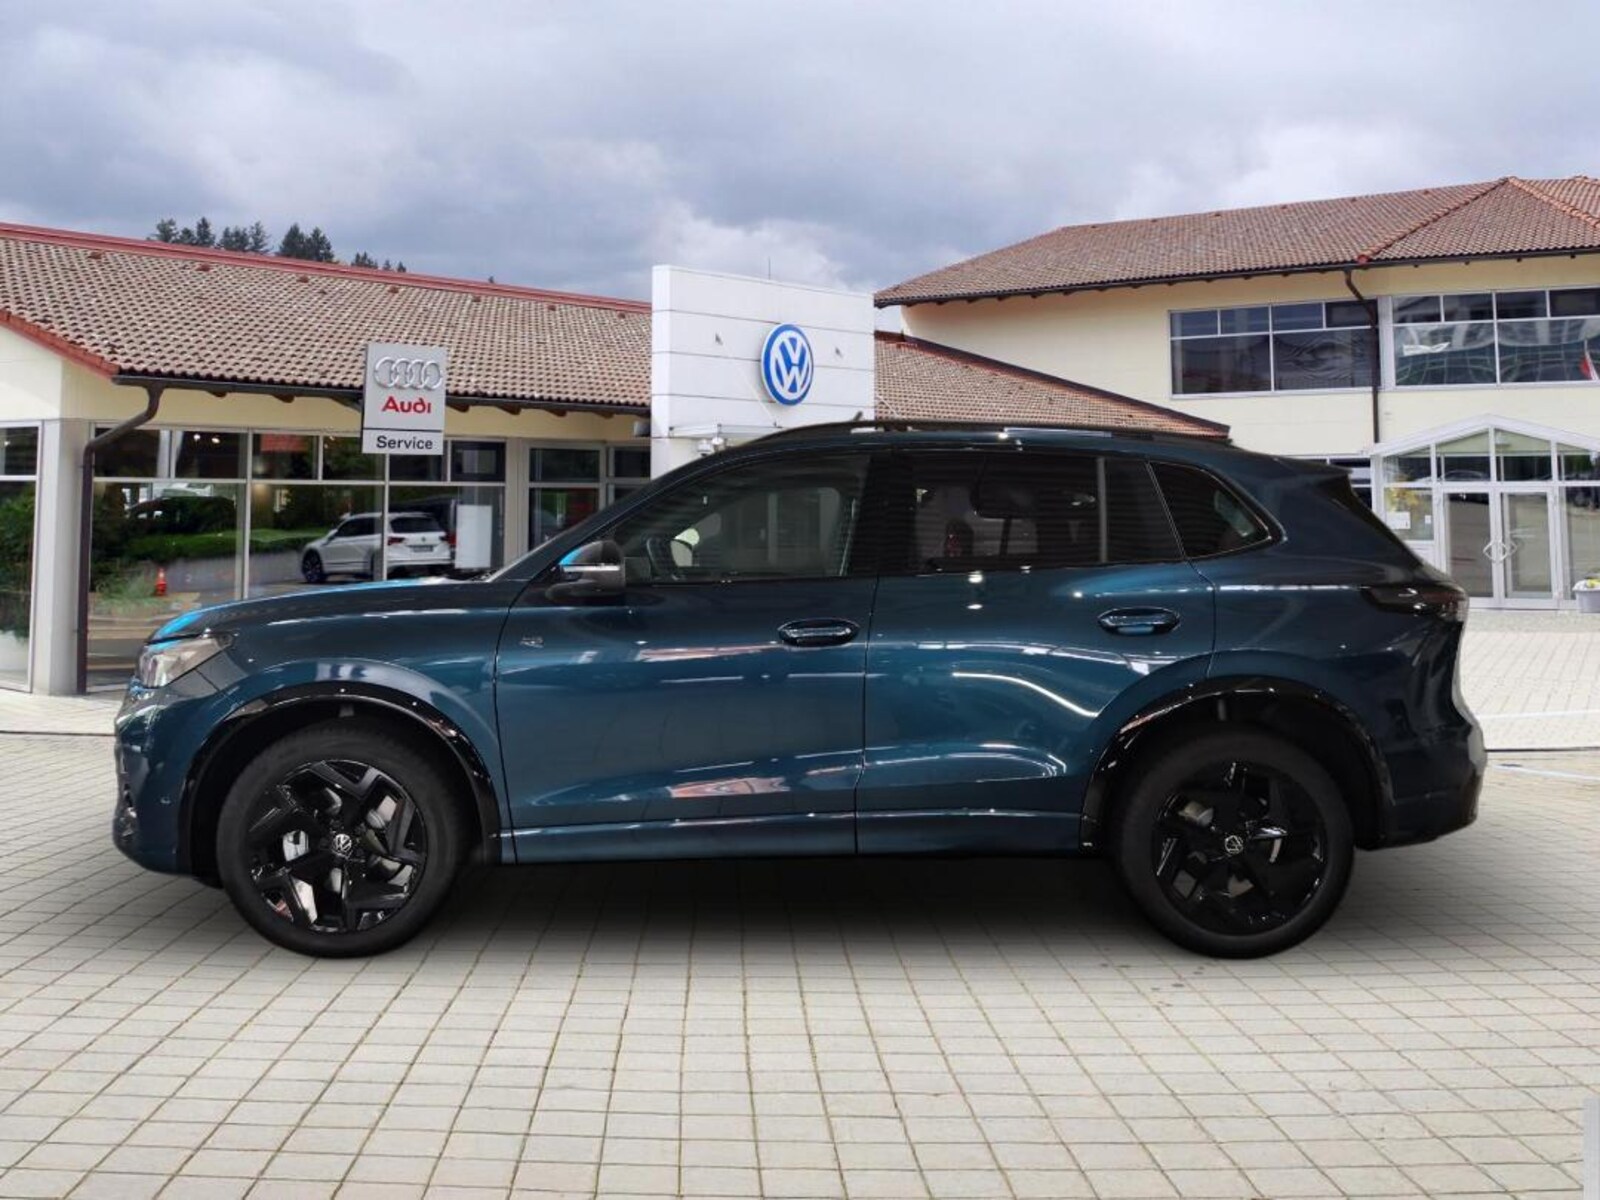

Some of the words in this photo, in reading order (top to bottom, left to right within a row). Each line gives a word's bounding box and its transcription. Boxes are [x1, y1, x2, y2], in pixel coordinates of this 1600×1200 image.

[769, 331, 812, 399] VW
[382, 396, 431, 413] Audi
[376, 435, 433, 450] Service
